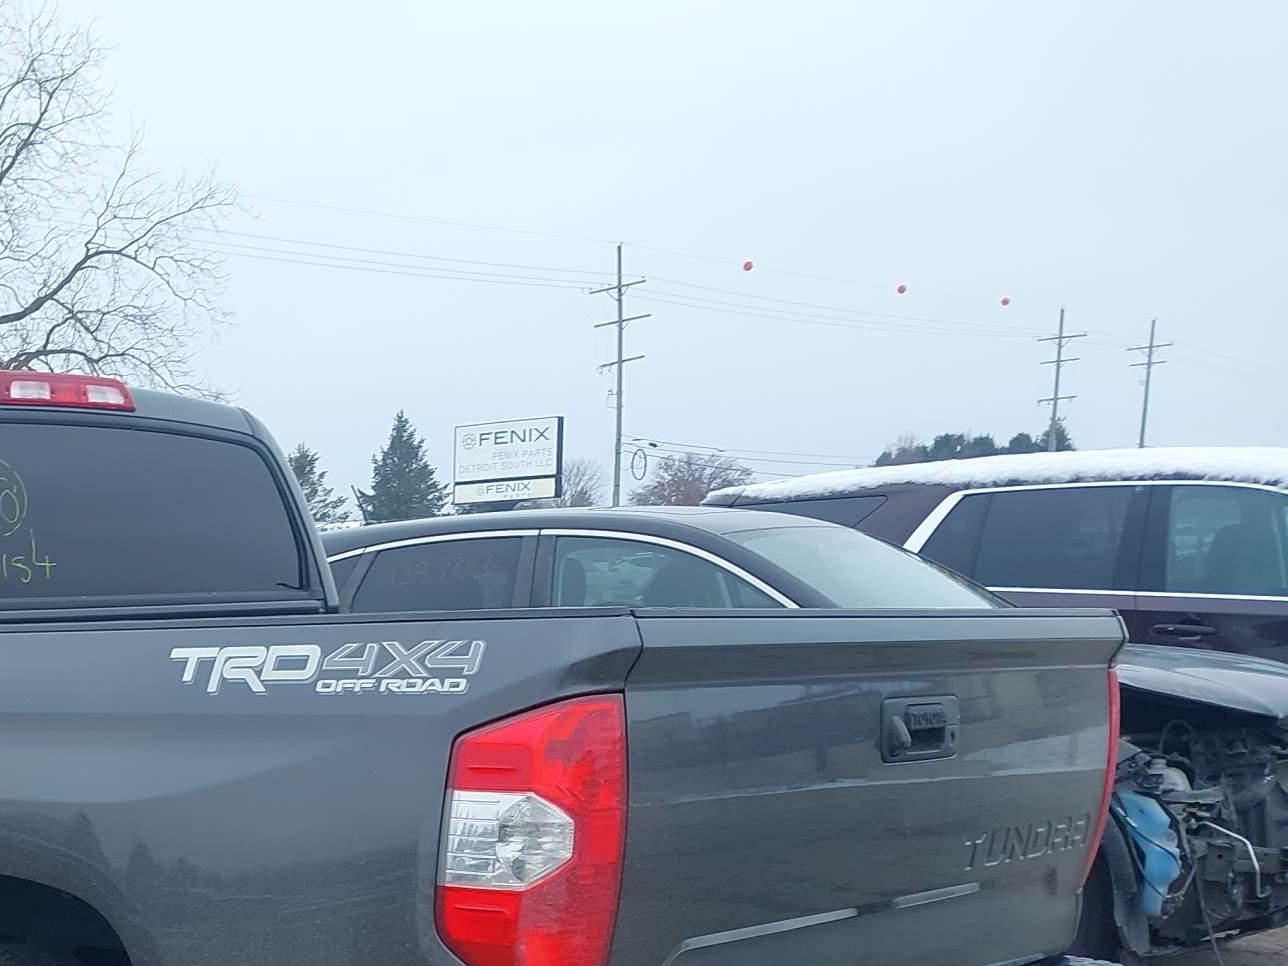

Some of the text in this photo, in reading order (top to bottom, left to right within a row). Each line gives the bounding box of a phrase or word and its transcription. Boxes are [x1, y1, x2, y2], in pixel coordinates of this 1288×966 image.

[479, 426, 551, 446] FENIX
[486, 481, 531, 495] FENIX
[170, 644, 322, 695] TRD
[315, 678, 469, 695] OFF ROAD
[963, 812, 1092, 872] TUNDRA
